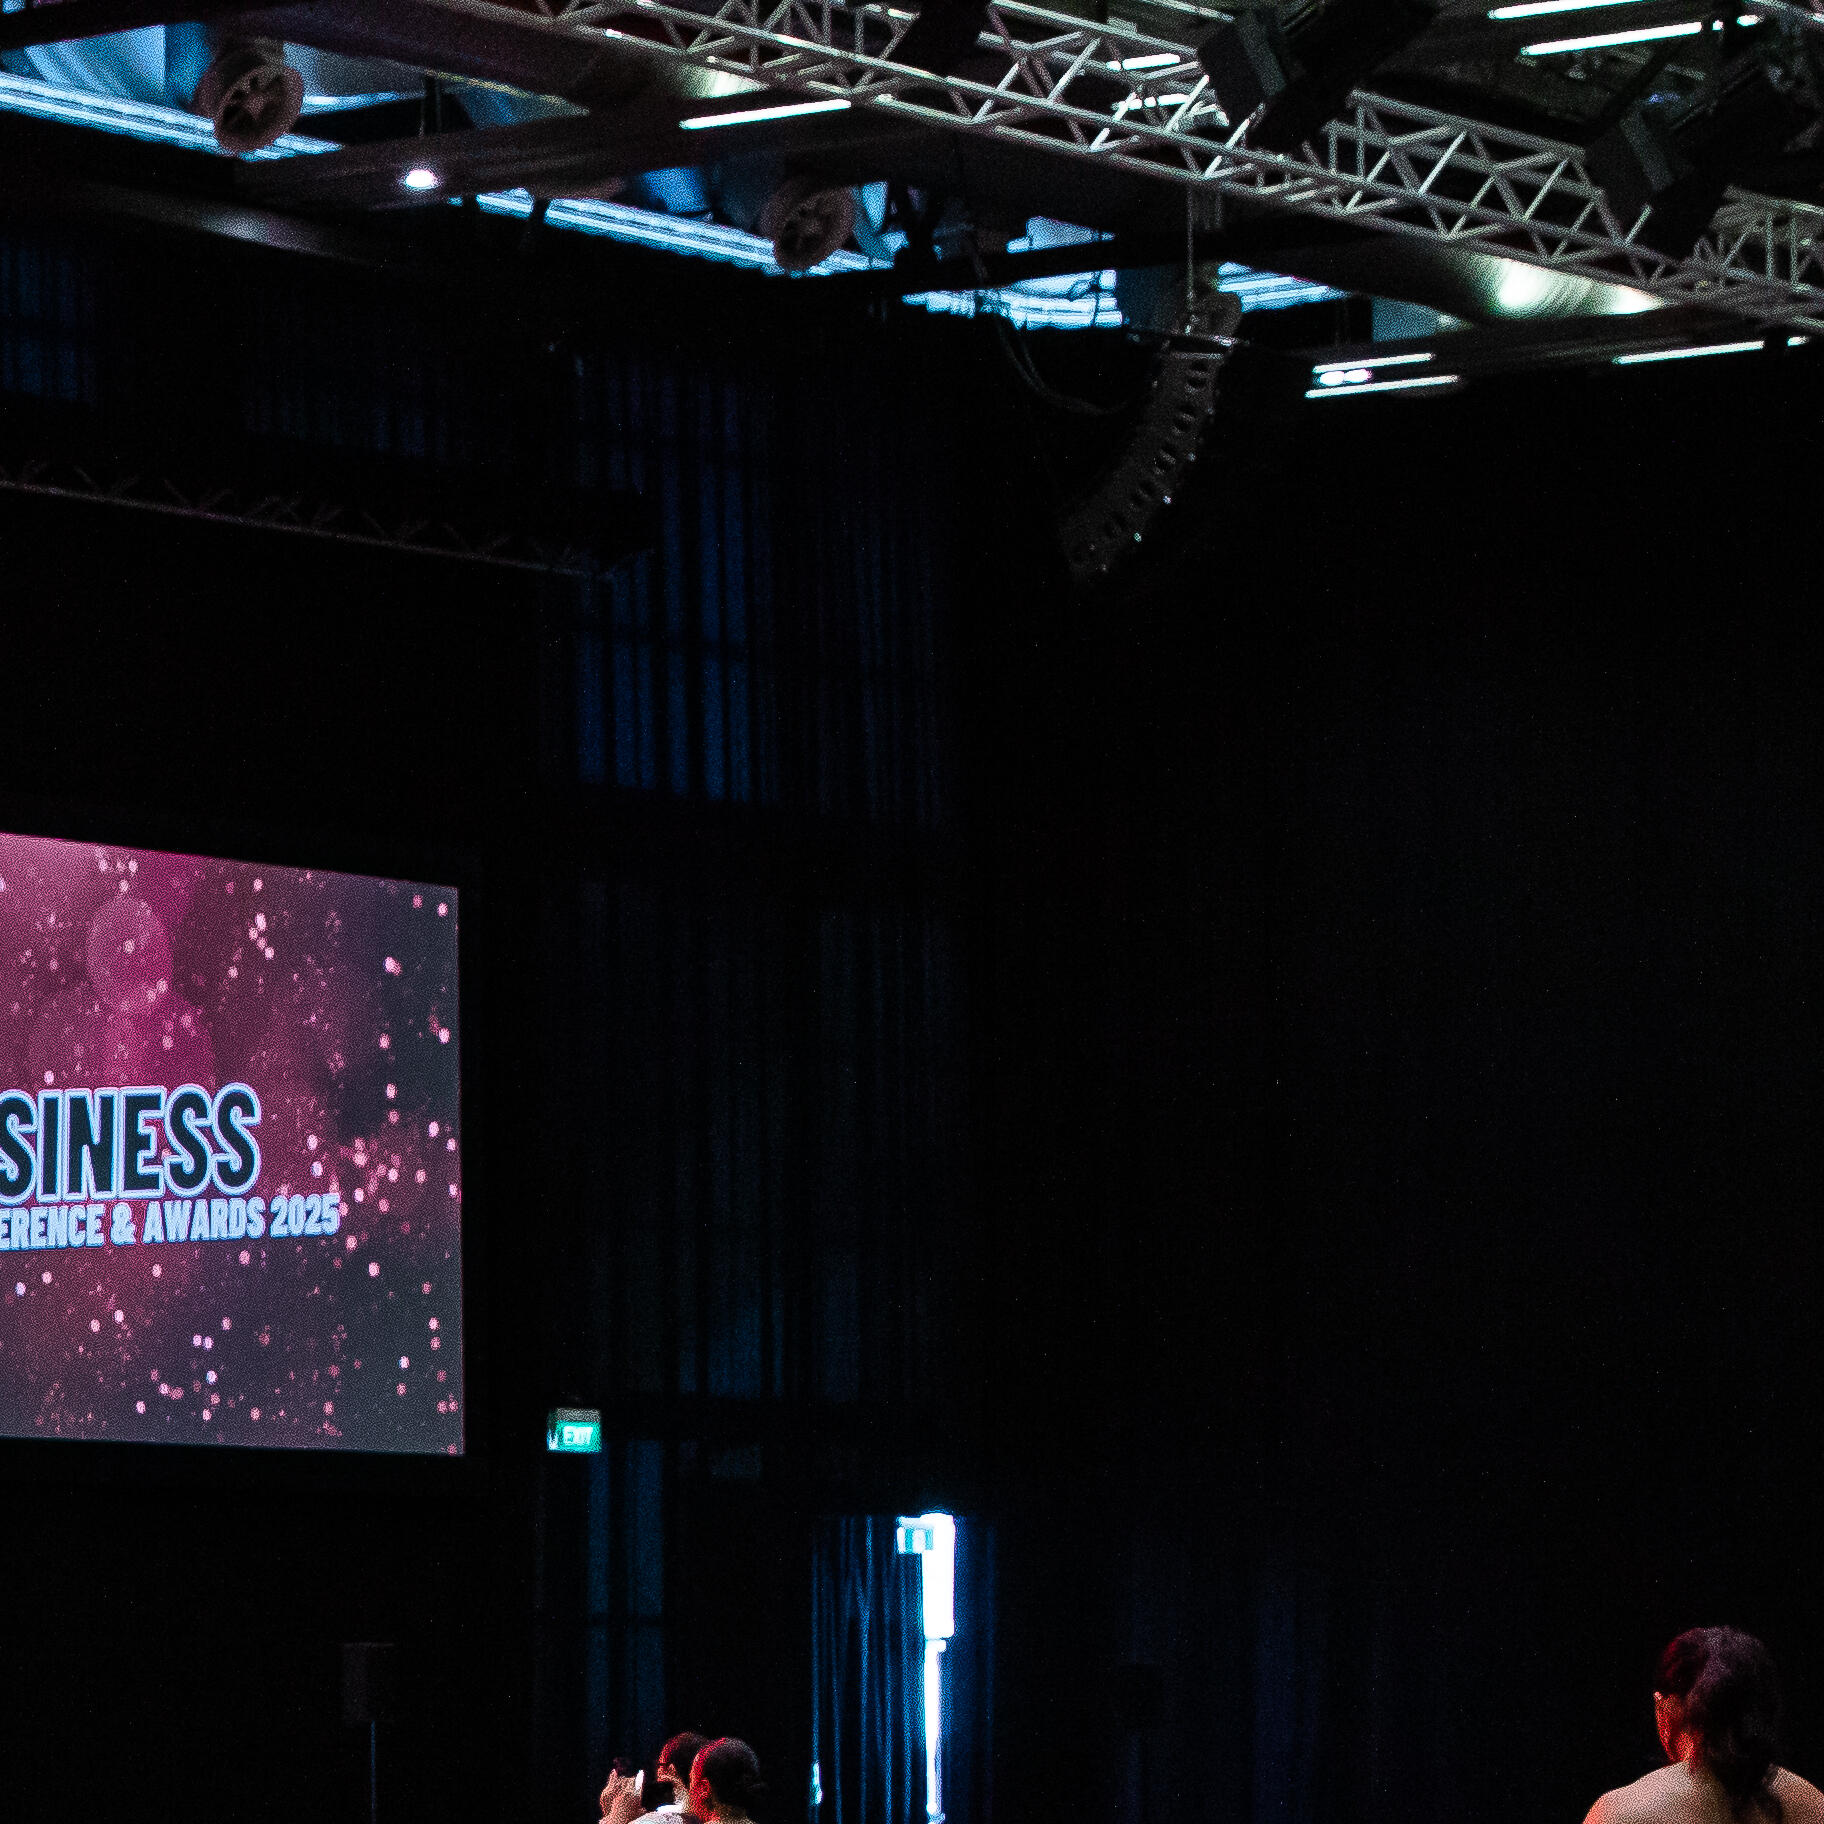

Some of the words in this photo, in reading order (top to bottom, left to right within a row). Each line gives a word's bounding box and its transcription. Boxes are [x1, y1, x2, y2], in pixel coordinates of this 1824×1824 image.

[109, 1201, 136, 1247] &
[142, 1196, 264, 1244] AWARDS
[269, 1193, 341, 1236] 2025
[563, 1425, 594, 1446] EXIT
